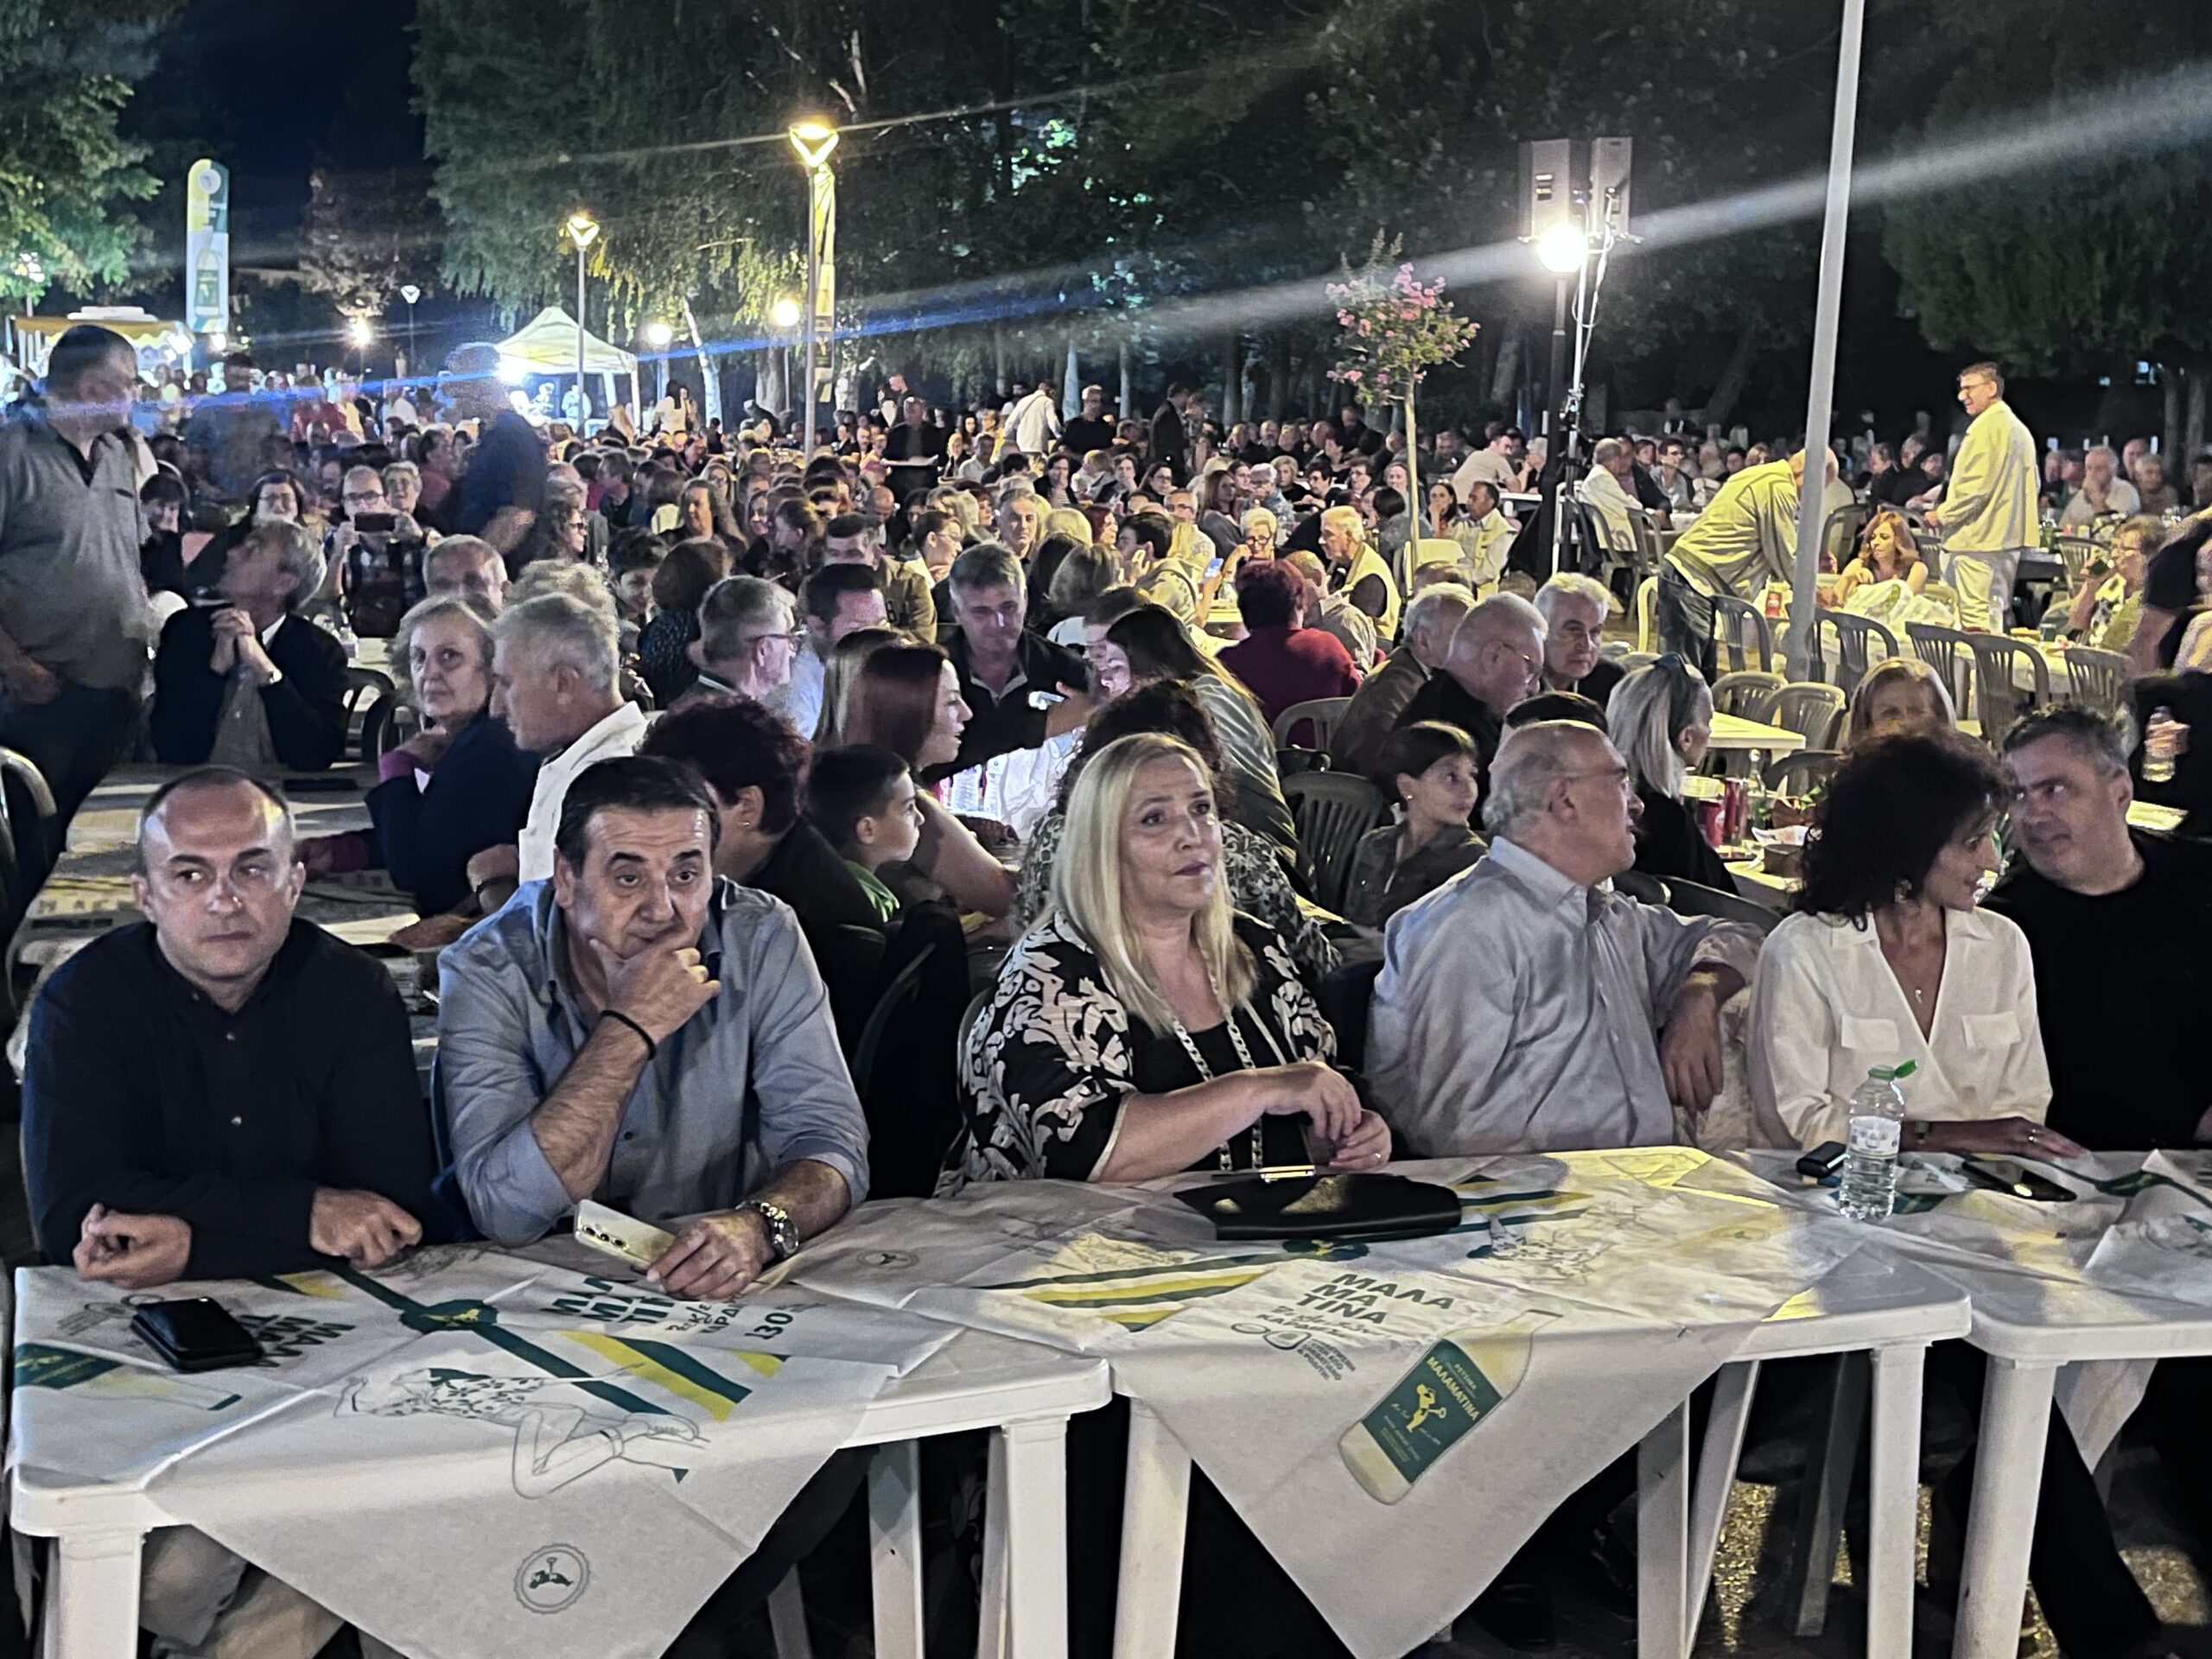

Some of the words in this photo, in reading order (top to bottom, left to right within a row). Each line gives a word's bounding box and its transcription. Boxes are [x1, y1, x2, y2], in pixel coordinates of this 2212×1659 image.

[1311, 1284, 1378, 1307] ΜΑ
[1332, 1274, 1455, 1310] ΜΑΛΑ
[1296, 1294, 1388, 1325] ΤΙΝΑ
[744, 1312, 794, 1340] 130
[1427, 1356, 1480, 1421] ΜΑΛΑΜΑΤΙΝΑ
